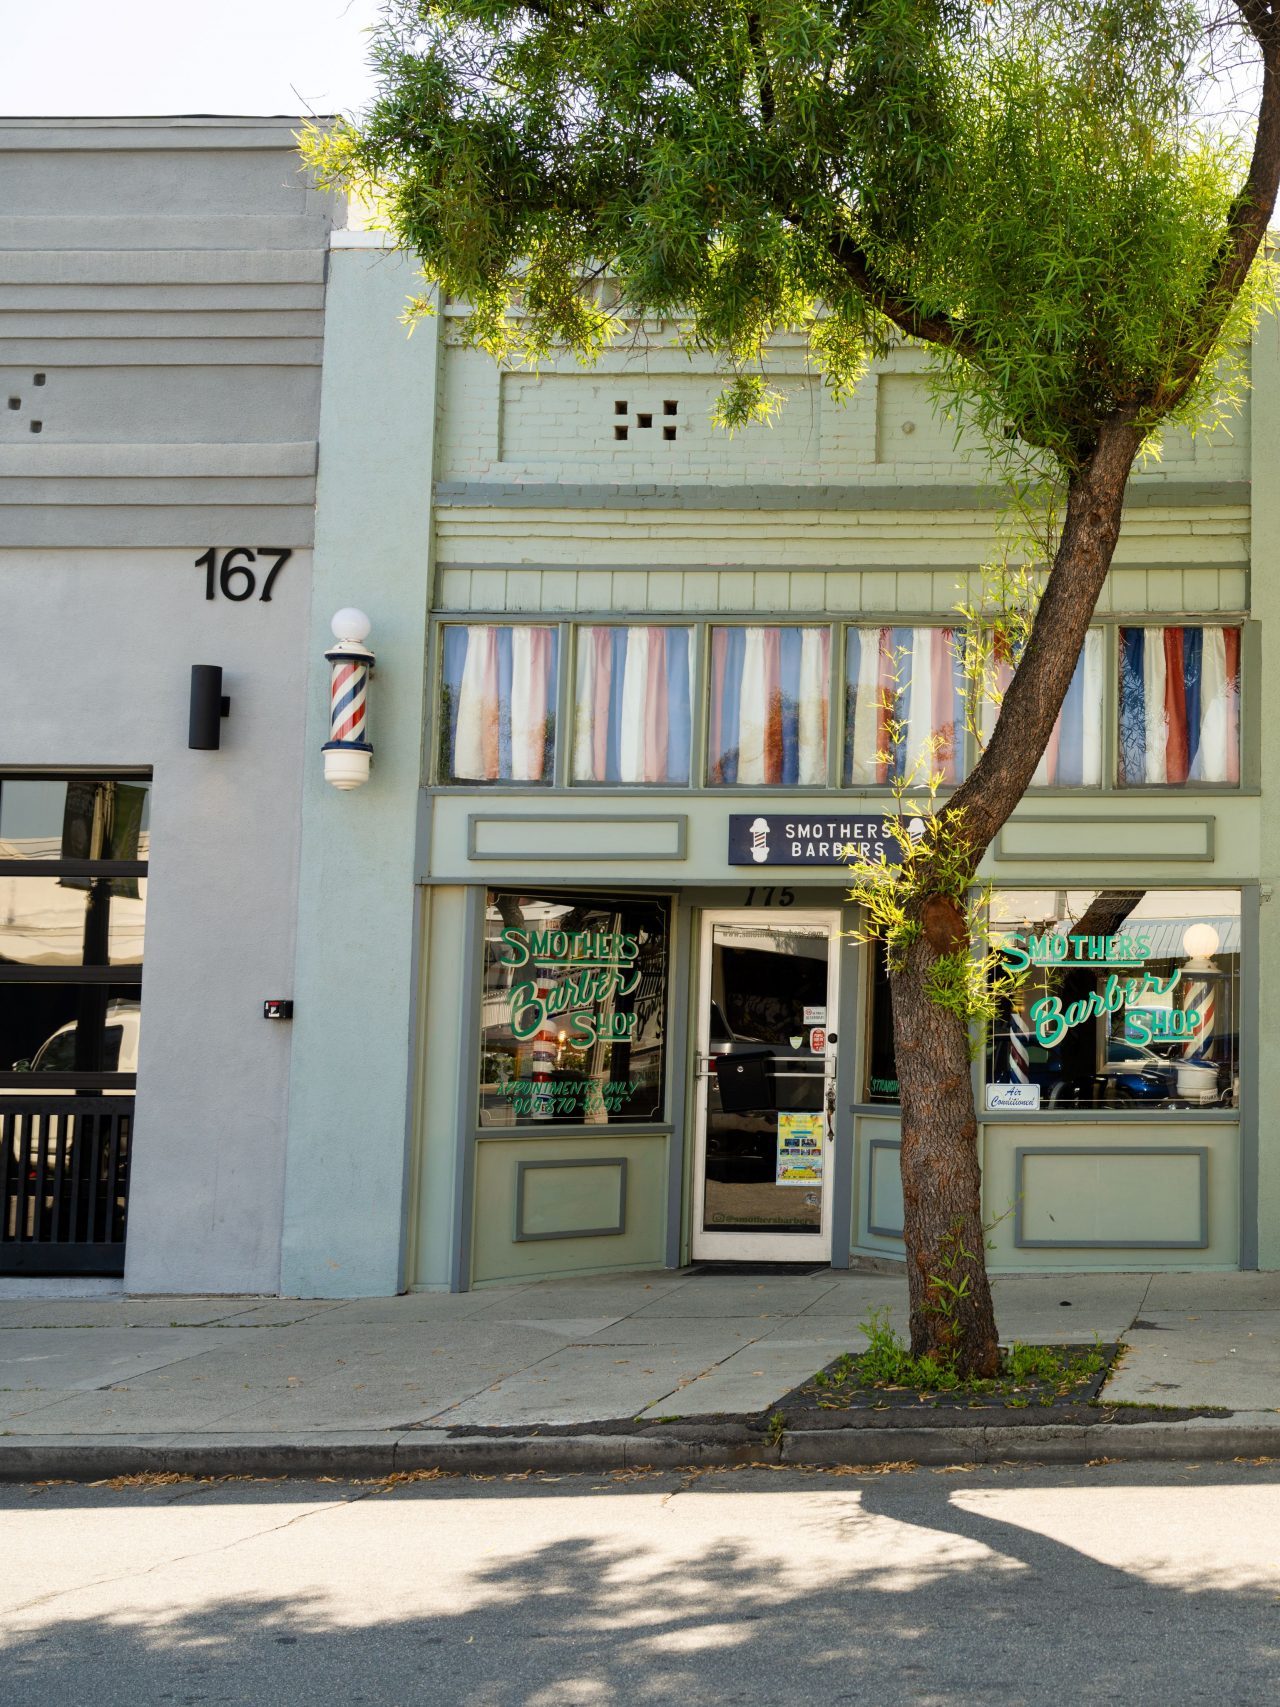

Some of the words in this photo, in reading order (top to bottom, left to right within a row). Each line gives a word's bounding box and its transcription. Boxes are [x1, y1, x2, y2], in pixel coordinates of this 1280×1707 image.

[194, 547, 293, 601] 167
[785, 823, 893, 839] SMOTHERS
[791, 842, 885, 857] BARBERS
[744, 886, 796, 907] 175
[500, 926, 640, 968] SMOTHERS
[1000, 933, 1152, 972] SMOTHERS
[509, 968, 642, 1041] Barber
[1030, 968, 1182, 1049] Barber
[570, 1011, 638, 1049] SHOP
[1124, 1008, 1202, 1047] SHOP
[602, 1080, 639, 1095] ONLY
[990, 1095, 1036, 1107] Conditioned
[1004, 1086, 1023, 1097] Air
